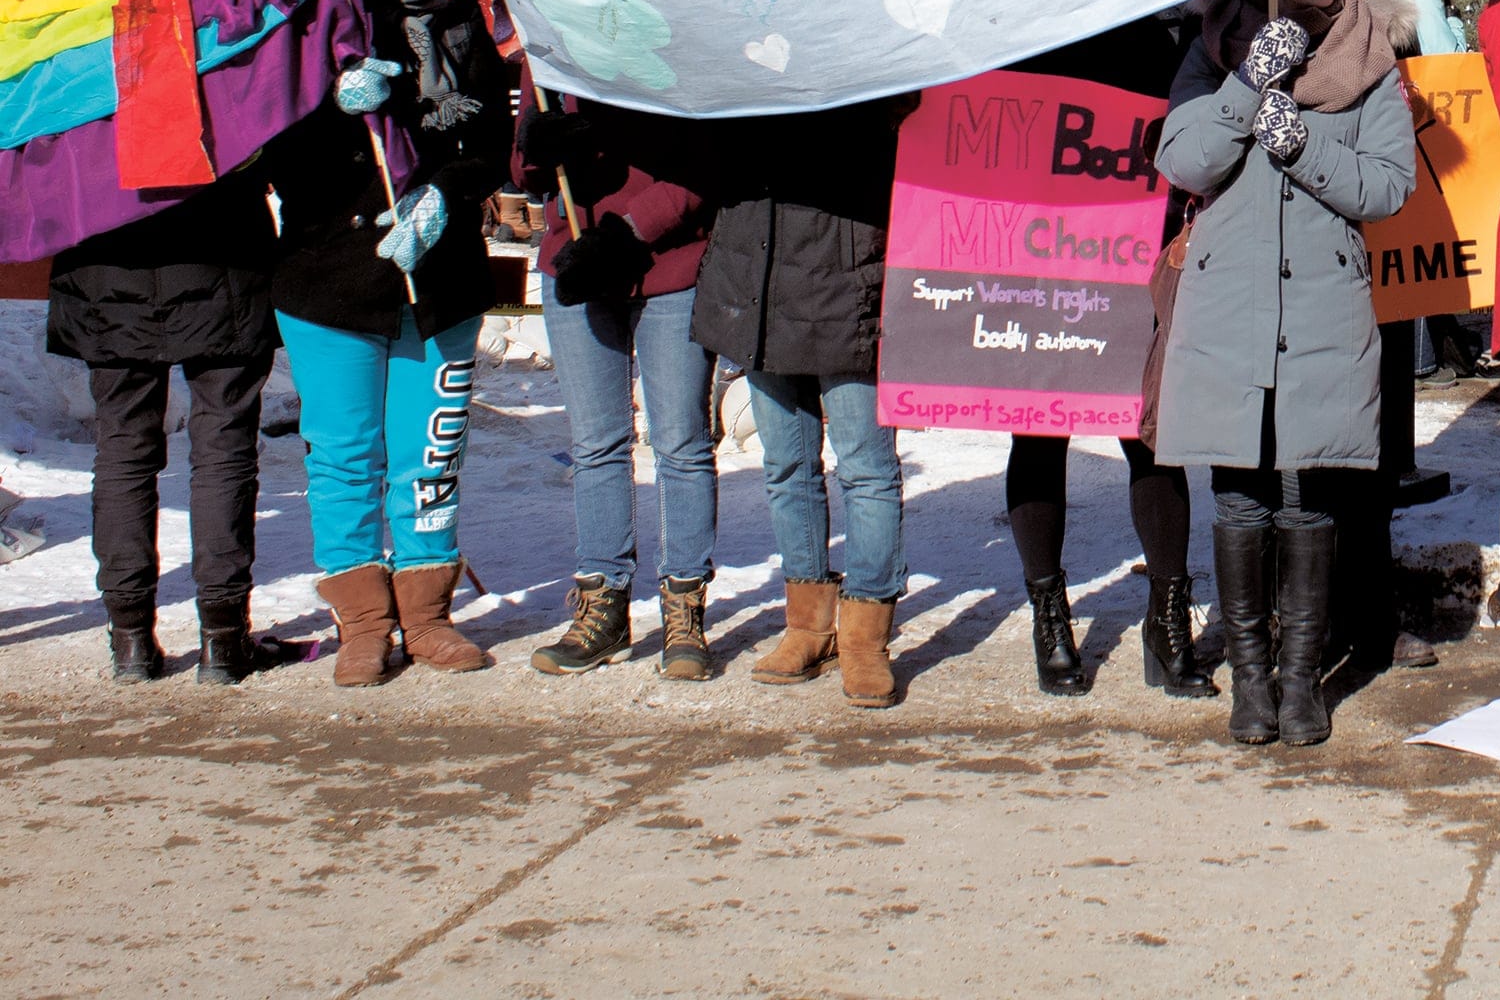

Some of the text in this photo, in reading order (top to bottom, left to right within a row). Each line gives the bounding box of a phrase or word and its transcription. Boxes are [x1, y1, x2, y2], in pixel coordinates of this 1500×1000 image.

[945, 94, 1044, 170] MY
[941, 201, 1028, 268] MY
[1366, 239, 1482, 287] AME
[913, 278, 974, 310] Support
[1035, 331, 1107, 355] autonomy
[894, 390, 989, 424] Support
[1050, 400, 1140, 431] Spaces!
